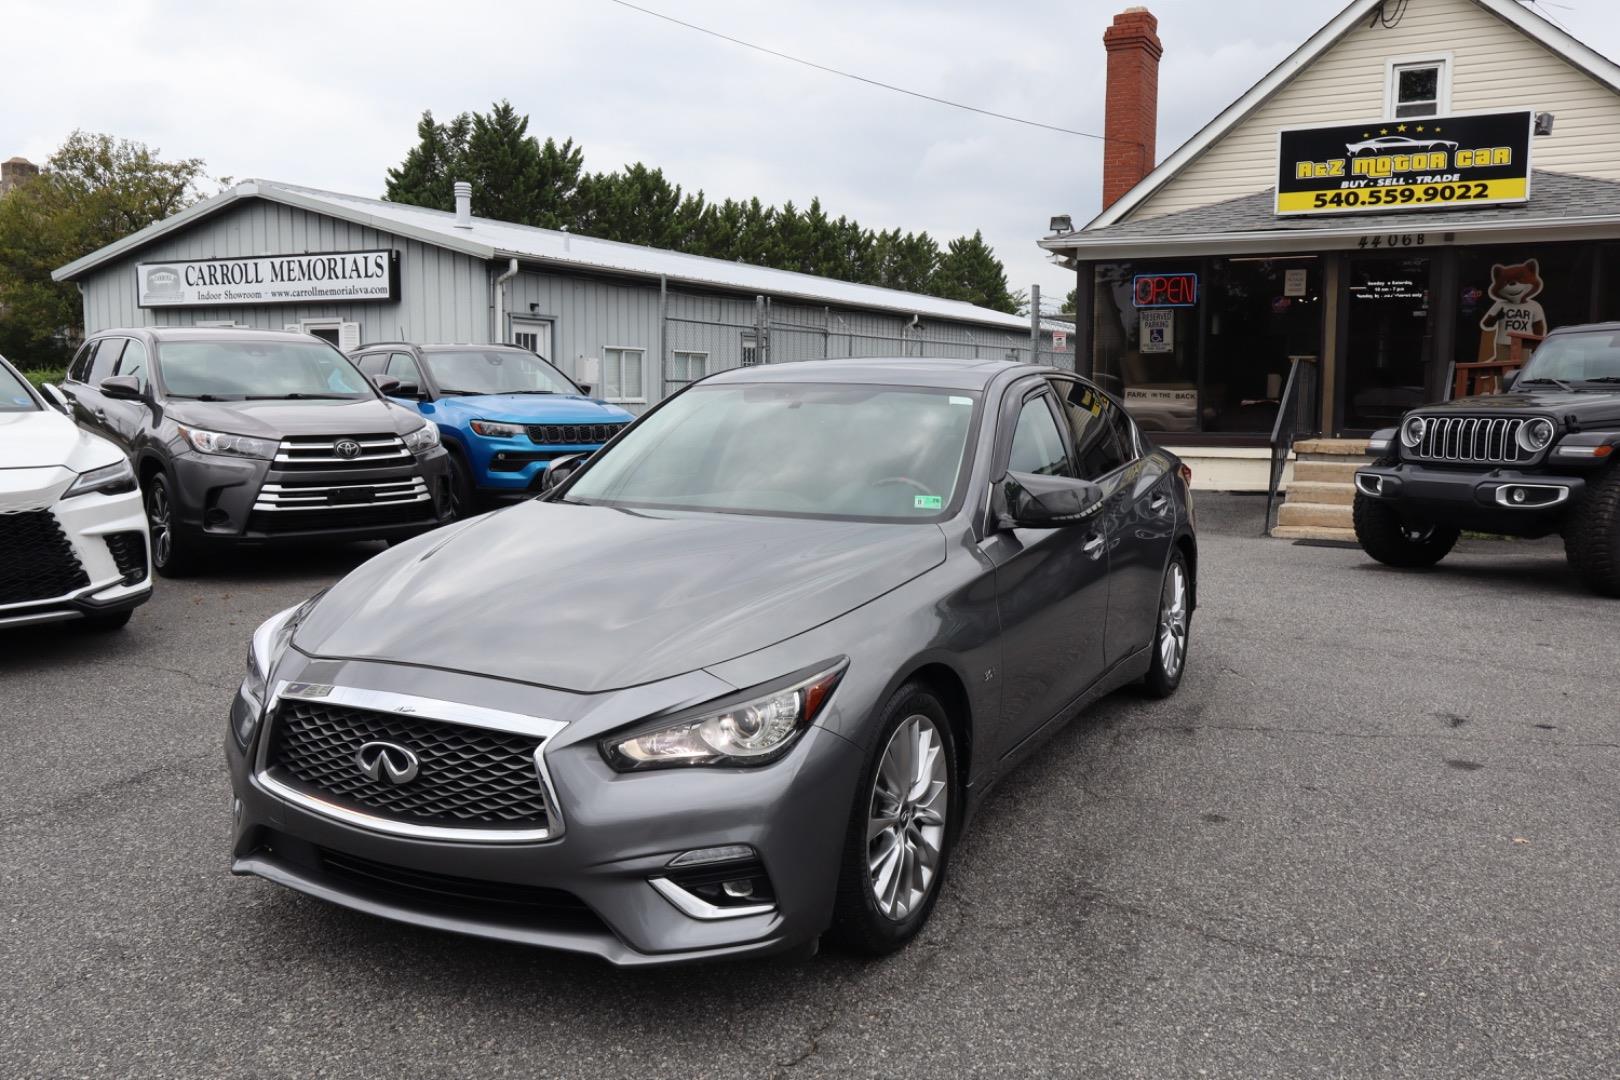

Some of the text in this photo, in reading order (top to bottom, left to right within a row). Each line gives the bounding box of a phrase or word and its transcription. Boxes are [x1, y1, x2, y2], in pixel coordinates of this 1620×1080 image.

[1340, 174, 1461, 189] BUY SELL TRADE
[1313, 183, 1489, 209] 540.559.9022
[1358, 233, 1425, 248] 4406B
[185, 255, 385, 287] CARROLL MEMORIALS
[197, 285, 388, 300] Indoor Showroom www.carrollmemorialsva.com
[1136, 277, 1195, 304] OPEN
[1506, 308, 1530, 320] CAR
[1505, 320, 1528, 332] FOX
[1127, 391, 1147, 399] PARK
